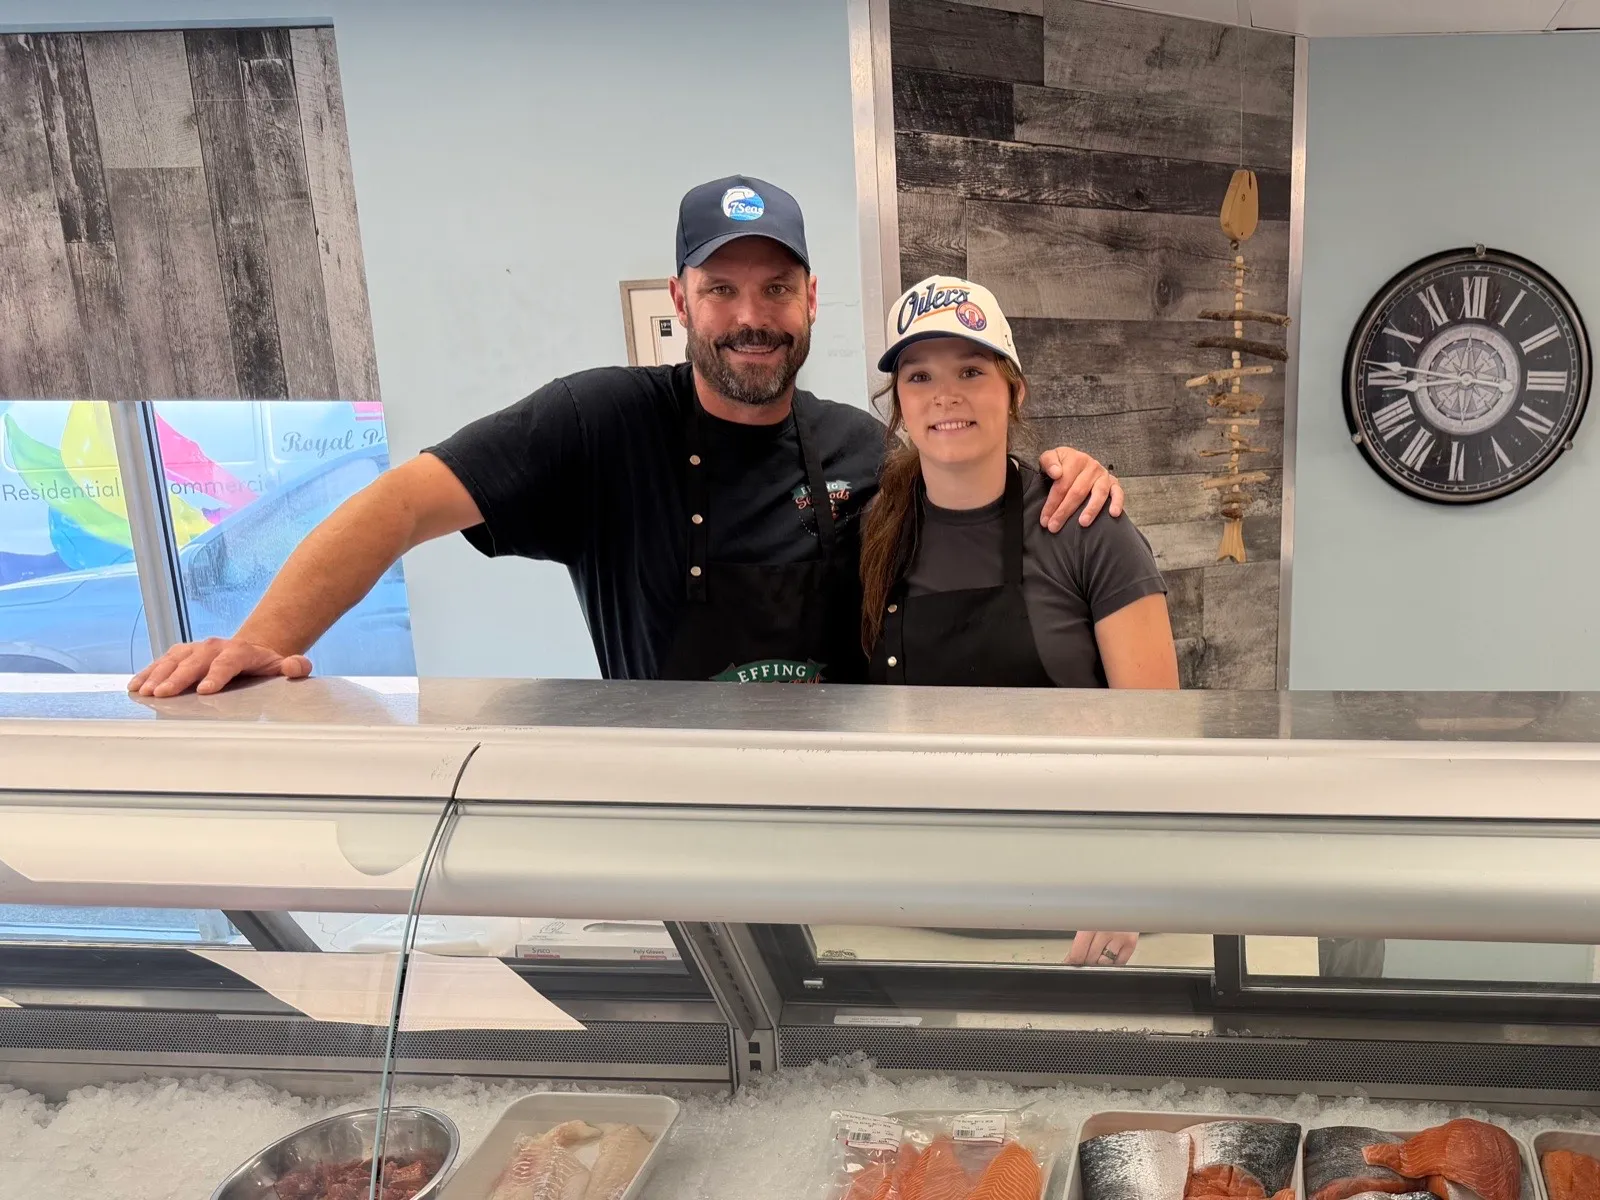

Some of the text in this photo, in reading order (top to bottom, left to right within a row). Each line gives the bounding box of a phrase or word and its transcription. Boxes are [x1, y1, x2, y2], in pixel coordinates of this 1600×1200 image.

[897, 282, 971, 335] Oilers
[1416, 284, 1450, 331] XI
[1458, 276, 1490, 320] XII
[1498, 288, 1528, 328] I
[1382, 320, 1425, 353] X
[1519, 323, 1562, 356] II
[1525, 370, 1568, 393] III
[1371, 394, 1417, 442] VIII
[1515, 403, 1556, 443] IV
[281, 429, 355, 458] Royal
[1399, 425, 1437, 473] VII
[1448, 441, 1465, 482] VI
[1490, 435, 1514, 474] V
[2, 477, 120, 501] Residential
[737, 664, 807, 683] EFFING
